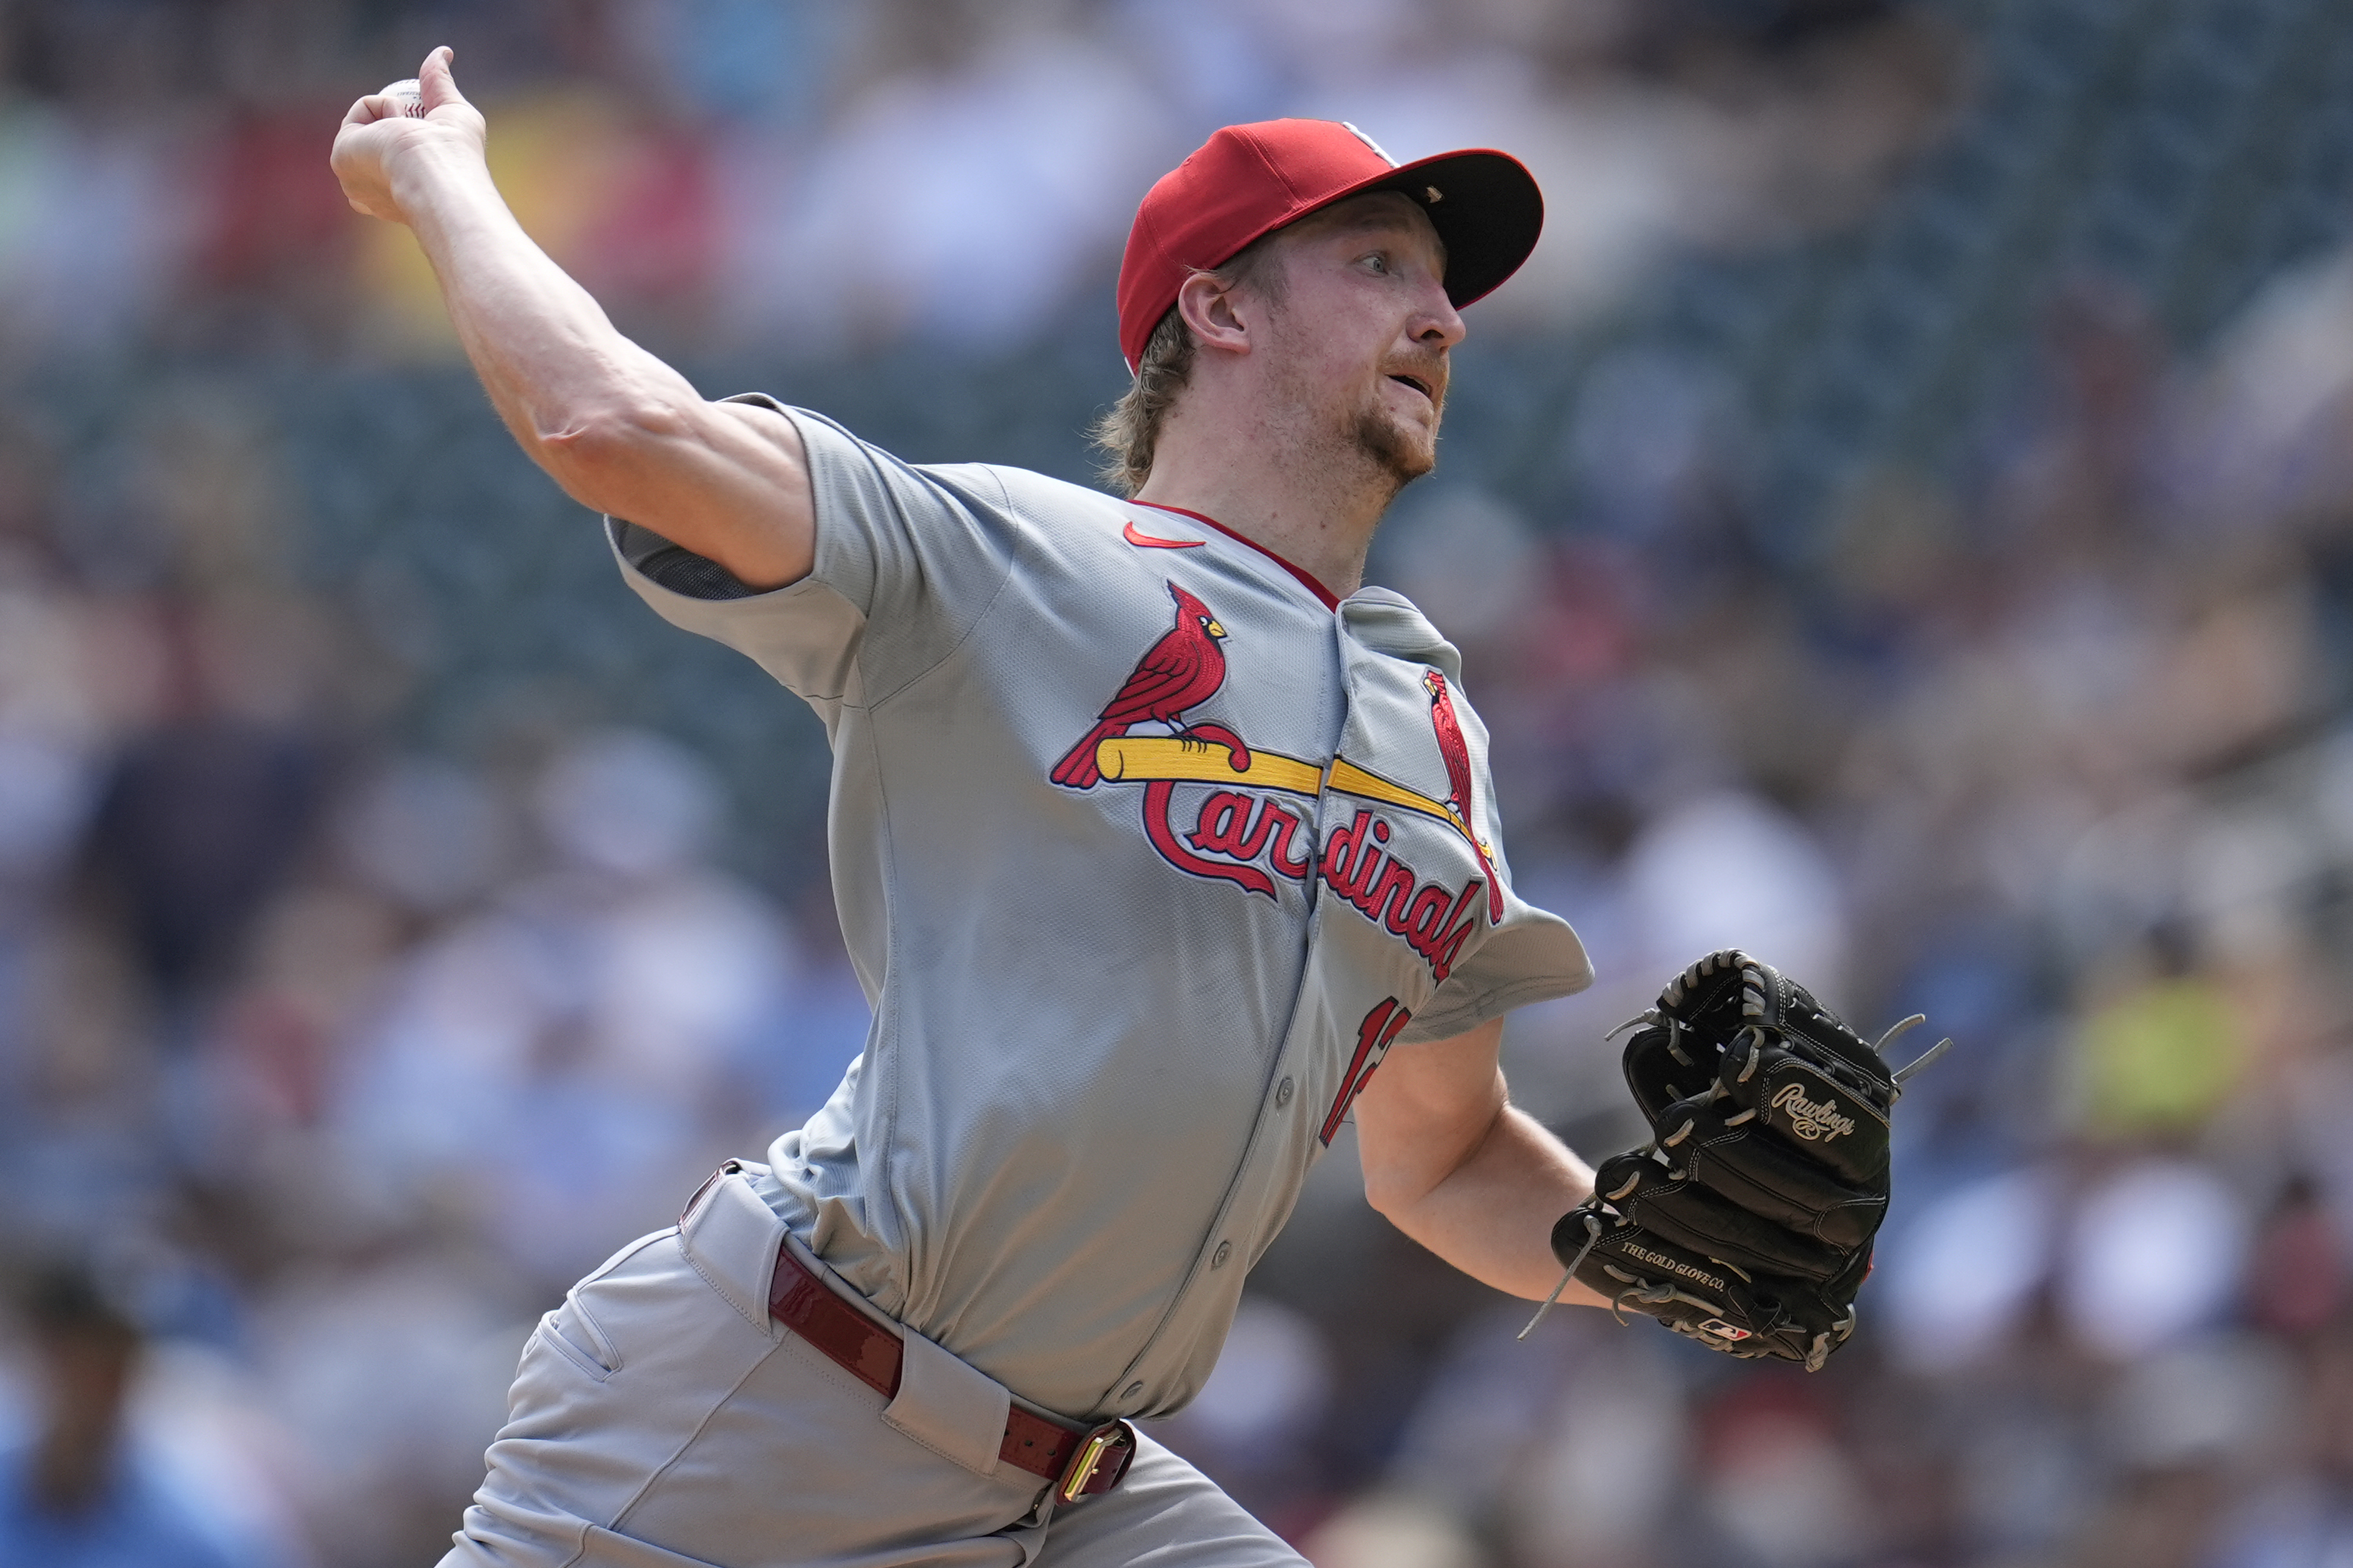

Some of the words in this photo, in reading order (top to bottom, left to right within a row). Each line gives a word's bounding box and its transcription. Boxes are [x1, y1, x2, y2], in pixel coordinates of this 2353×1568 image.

[1142, 723, 1483, 990] Cardinals
[1770, 1082, 1856, 1143] Rawlings
[1621, 1241, 1647, 1260] THE
[1645, 1252, 1676, 1270] GOLD
[1675, 1263, 1711, 1285] GLOVE
[1708, 1277, 1724, 1292] CO.
